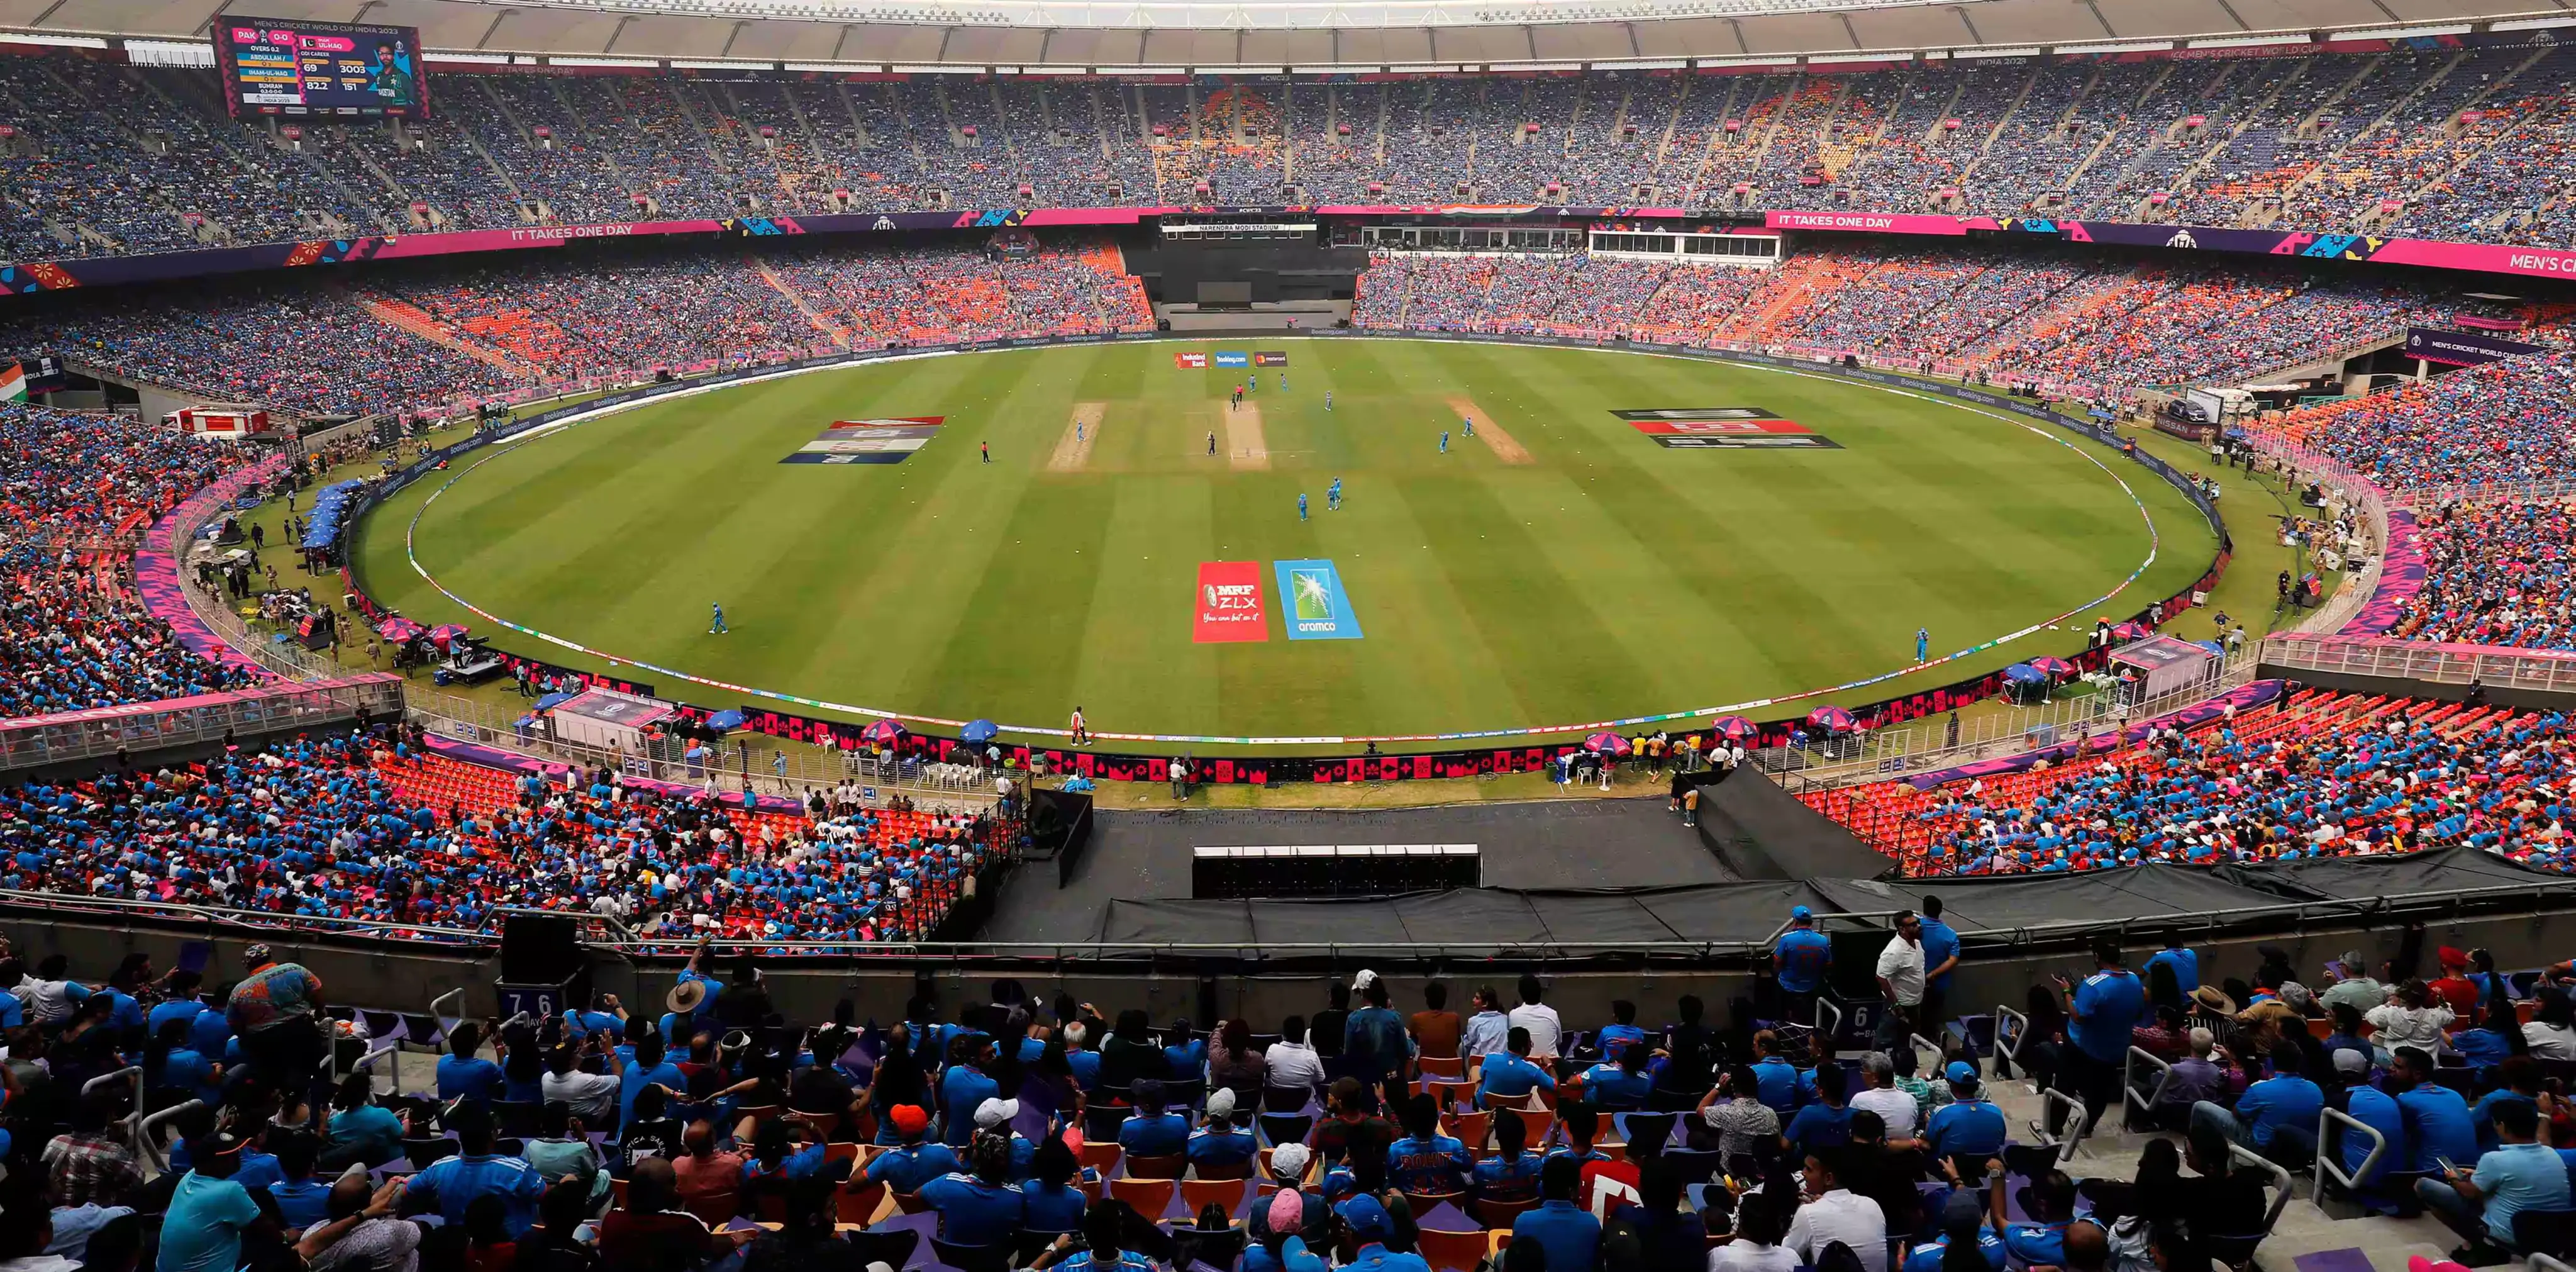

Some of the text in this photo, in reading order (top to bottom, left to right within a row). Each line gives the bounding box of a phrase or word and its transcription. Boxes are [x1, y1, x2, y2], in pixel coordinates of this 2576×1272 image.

[254, 20, 277, 28] MEN'S
[238, 31, 257, 40] PAK
[2187, 50, 2216, 58] MEN'S
[2218, 48, 2259, 57] CRICKET
[2301, 45, 2322, 53] CUP
[304, 64, 318, 72] 69
[340, 65, 365, 74] 3003
[306, 82, 328, 90] 82.2
[1779, 215, 1893, 228] IT TAKES ONE DAY
[512, 225, 633, 240] IT TAKES ONE DAY
[2510, 254, 2559, 271] MEN'S
[1013, 337, 1050, 345] Booking.com
[1116, 332, 1152, 340] Booking.com
[907, 345, 945, 354] Booking.com
[1629, 342, 1667, 352] Booking.com
[1683, 347, 1722, 357] Booking.com
[2432, 341, 2451, 349] MEN'S
[2452, 345, 2478, 354] CRICKET
[2479, 348, 2502, 358] WORLD
[854, 350, 891, 360] Booking.com
[1216, 355, 1246, 364] Booking.com
[1738, 351, 1776, 364] Booking.com
[802, 357, 839, 367] Booking.com
[1792, 360, 1830, 372] Booking.com
[752, 364, 788, 376] Booking.com
[1846, 369, 1884, 382] Booking.com
[699, 373, 736, 384] Booking.com
[1901, 377, 1940, 391] Booking.com
[646, 383, 684, 396] Booking.com
[594, 394, 631, 408] Booking.com
[1957, 389, 1995, 404] Booking.com
[544, 407, 579, 421] Booking.com
[2010, 401, 2047, 418] Booking.com
[2060, 416, 2089, 433] Booking.com
[2157, 417, 2188, 433] NISSAN
[450, 437, 482, 454] Booking.com
[1217, 585, 1255, 595] MRF
[1219, 597, 1257, 609] ZLX
[1203, 612, 1217, 623] You
[1231, 613, 1242, 622] bet
[1298, 622, 1336, 632] aramco
[509, 994, 552, 1014] 7 6
[1855, 1007, 1868, 1027] 6
[1400, 1152, 1453, 1169] ROHIT
